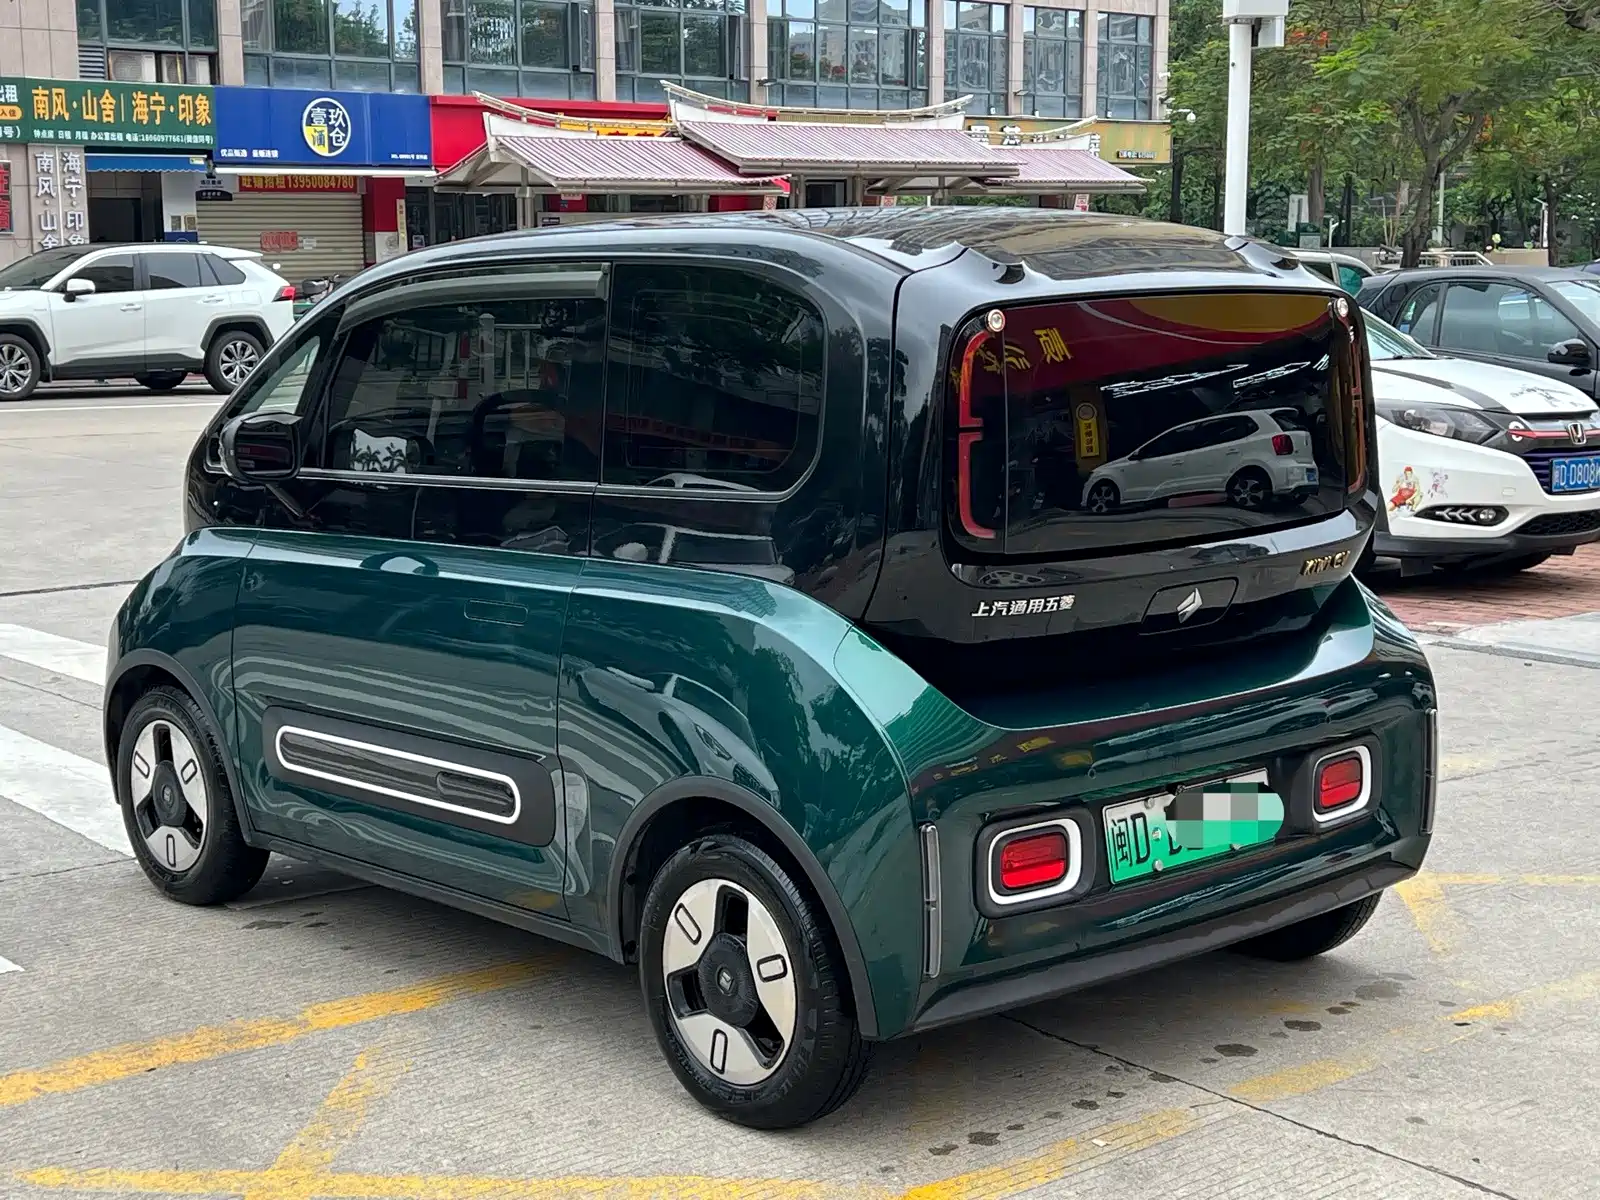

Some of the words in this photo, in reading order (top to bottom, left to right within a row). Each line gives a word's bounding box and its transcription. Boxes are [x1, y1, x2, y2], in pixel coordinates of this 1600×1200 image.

[971, 594, 1076, 617] 上汽通用五菱
